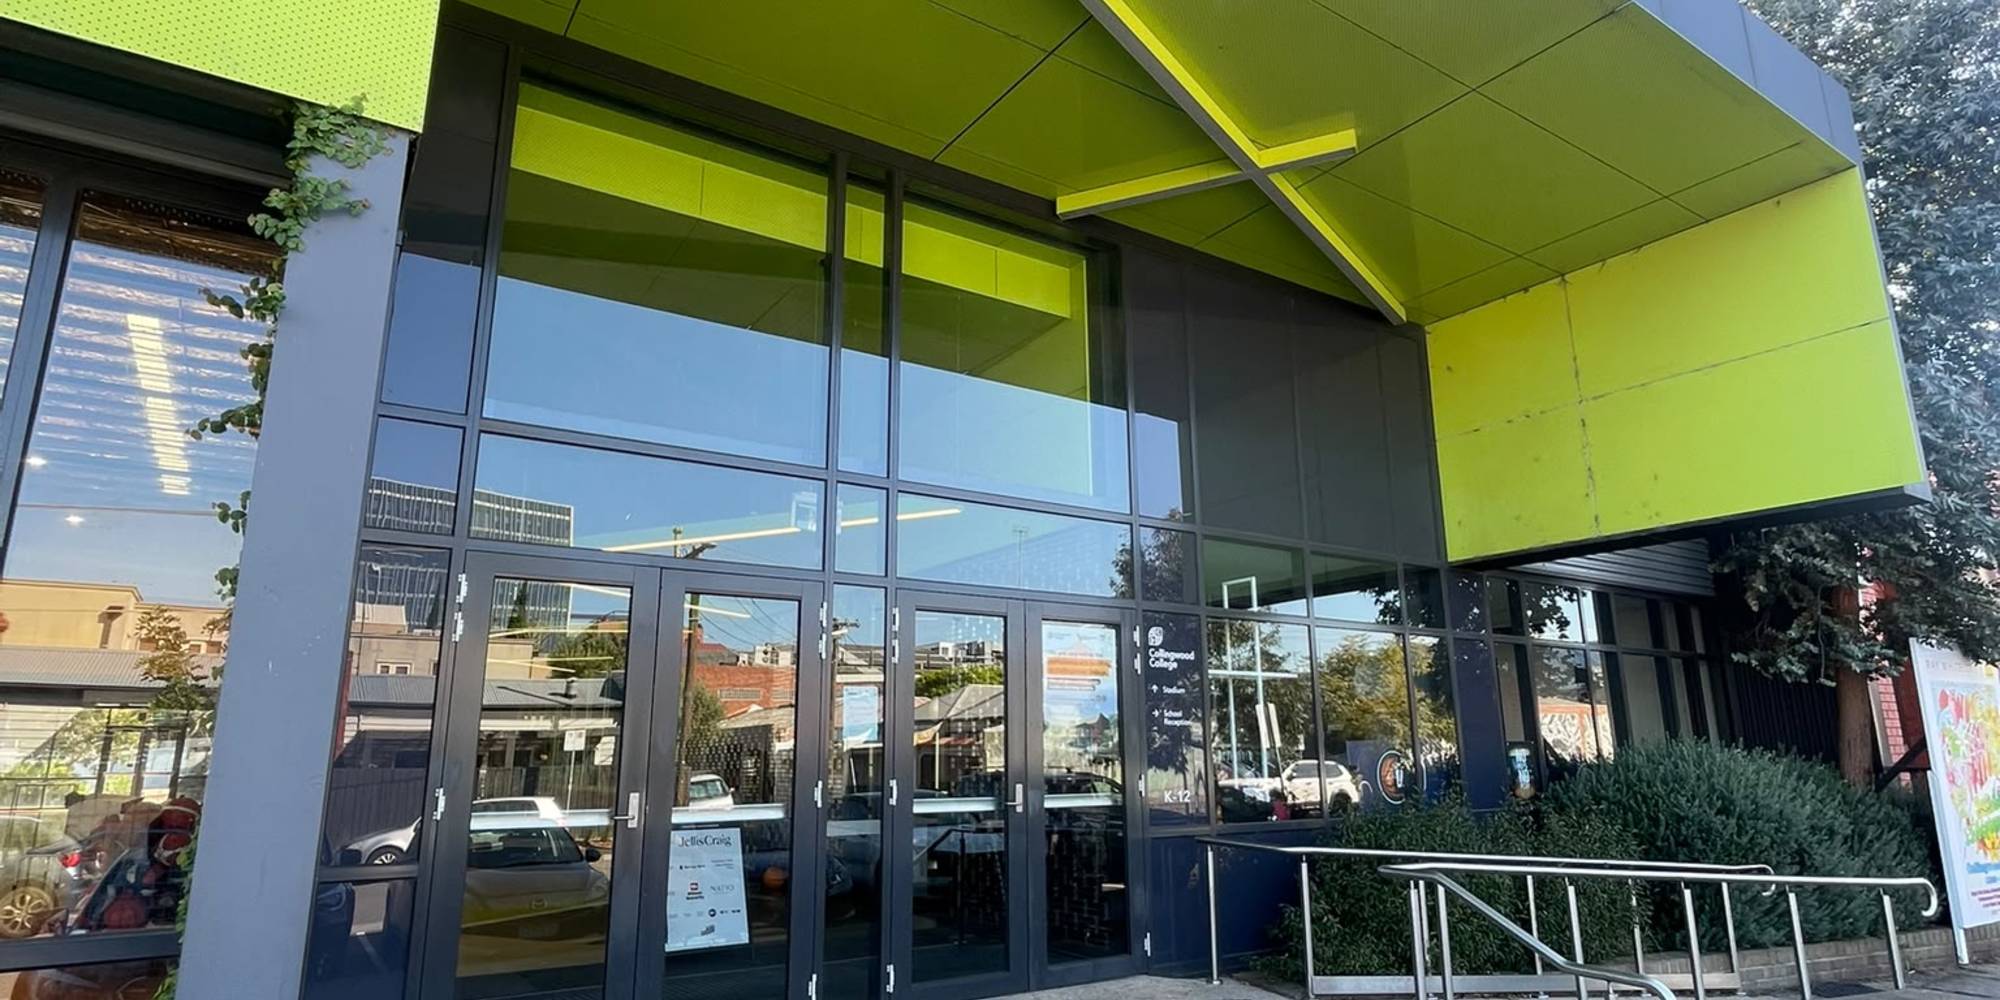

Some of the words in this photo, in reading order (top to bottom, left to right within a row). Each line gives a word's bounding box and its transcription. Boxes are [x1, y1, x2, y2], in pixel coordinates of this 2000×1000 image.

[1148, 648, 1195, 661] Collingwood
[1148, 658, 1178, 671] College
[1162, 685, 1186, 694] Stadium
[1163, 709, 1183, 718] School
[1164, 790, 1191, 803] K-12
